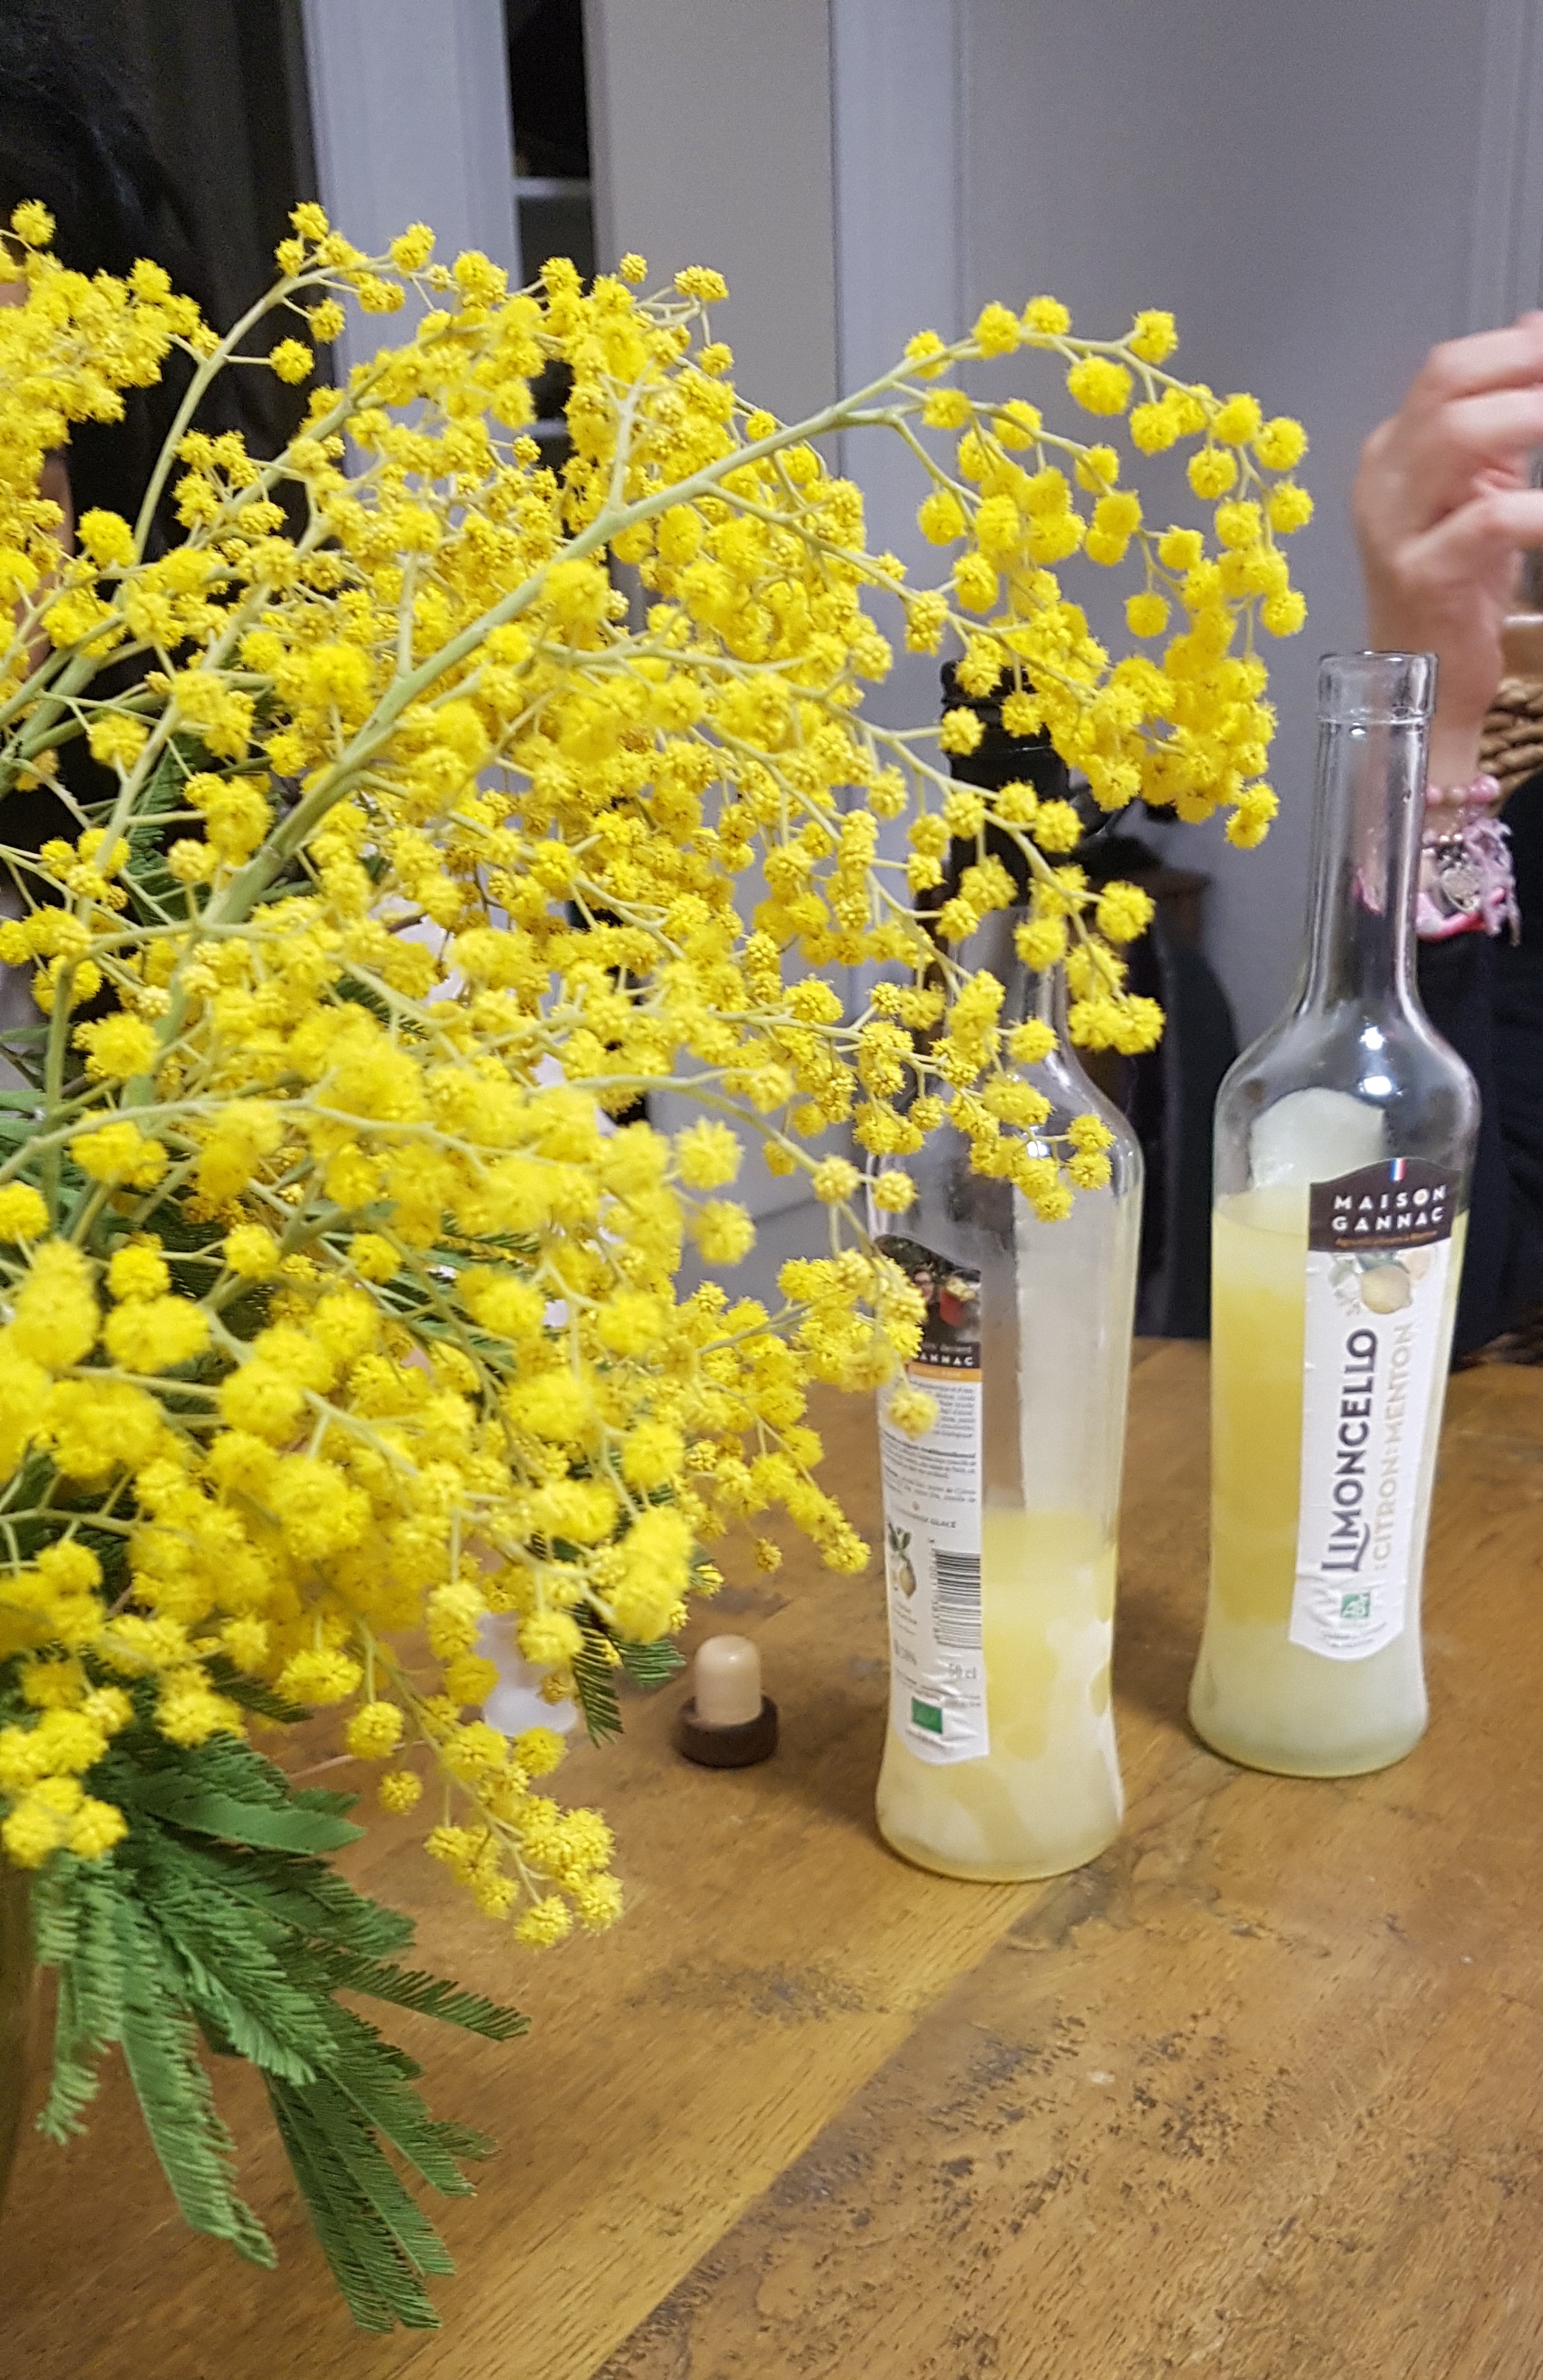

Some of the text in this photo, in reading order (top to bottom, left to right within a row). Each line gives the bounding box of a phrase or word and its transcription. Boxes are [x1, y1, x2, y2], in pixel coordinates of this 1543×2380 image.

[1332, 1206, 1445, 1232] GANNAC
[1334, 1184, 1447, 1211] MAISON
[919, 1352, 974, 1367] ANNAC
[1385, 1322, 1414, 1444] MENTON
[1321, 1328, 1379, 1573] LIMONCELLO
[1373, 1458, 1400, 1562] CITRON
